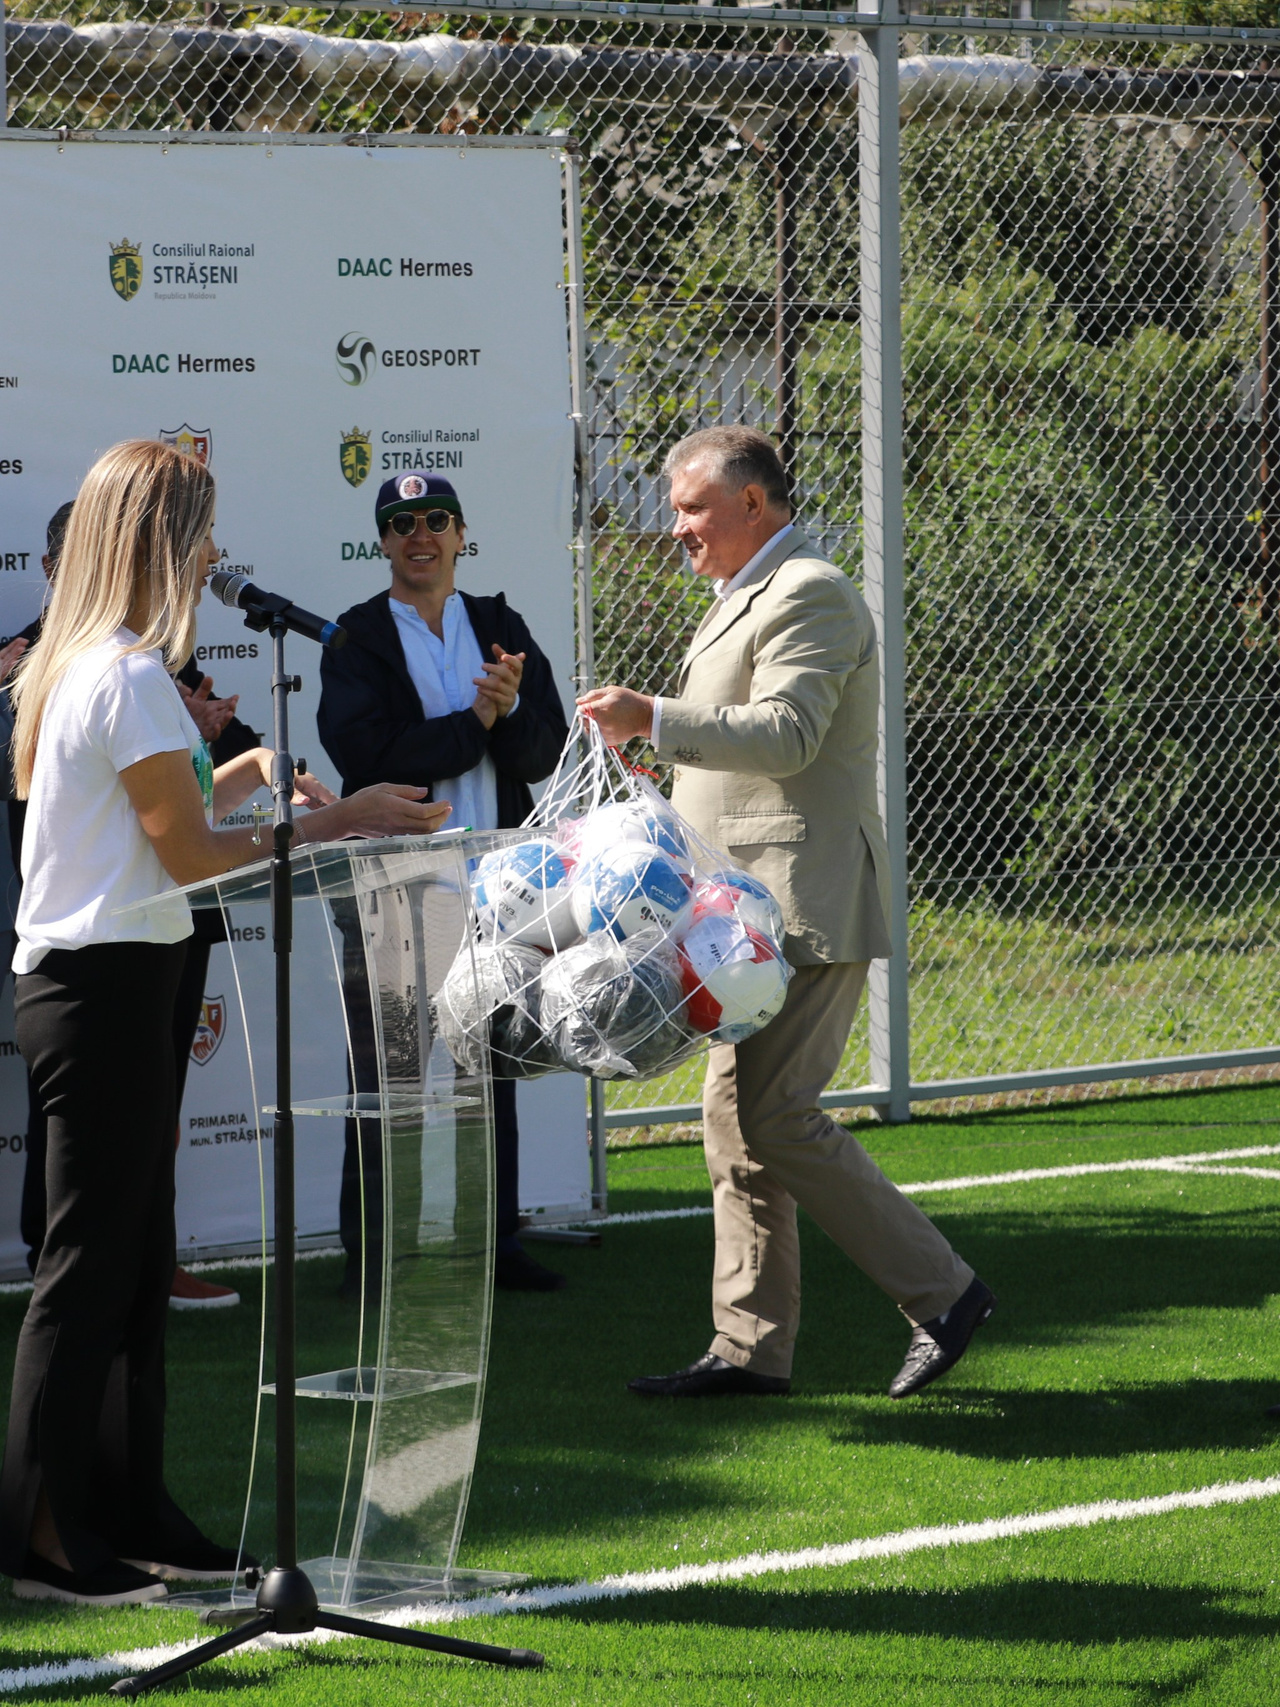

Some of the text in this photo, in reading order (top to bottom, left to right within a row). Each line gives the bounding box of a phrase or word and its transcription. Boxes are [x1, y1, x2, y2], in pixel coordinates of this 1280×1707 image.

[152, 242, 255, 258] Consiliul Raional
[337, 257, 474, 278] DAAC Hermes
[112, 353, 256, 374] DAAC Hermes
[381, 348, 482, 368] GEOSPORT
[381, 428, 480, 445] Consiliul Raional
[195, 642, 259, 661] ermes
[219, 811, 265, 827] Raionl
[189, 1112, 249, 1130] PRIMARIA
[189, 1136, 213, 1147] MUN.
